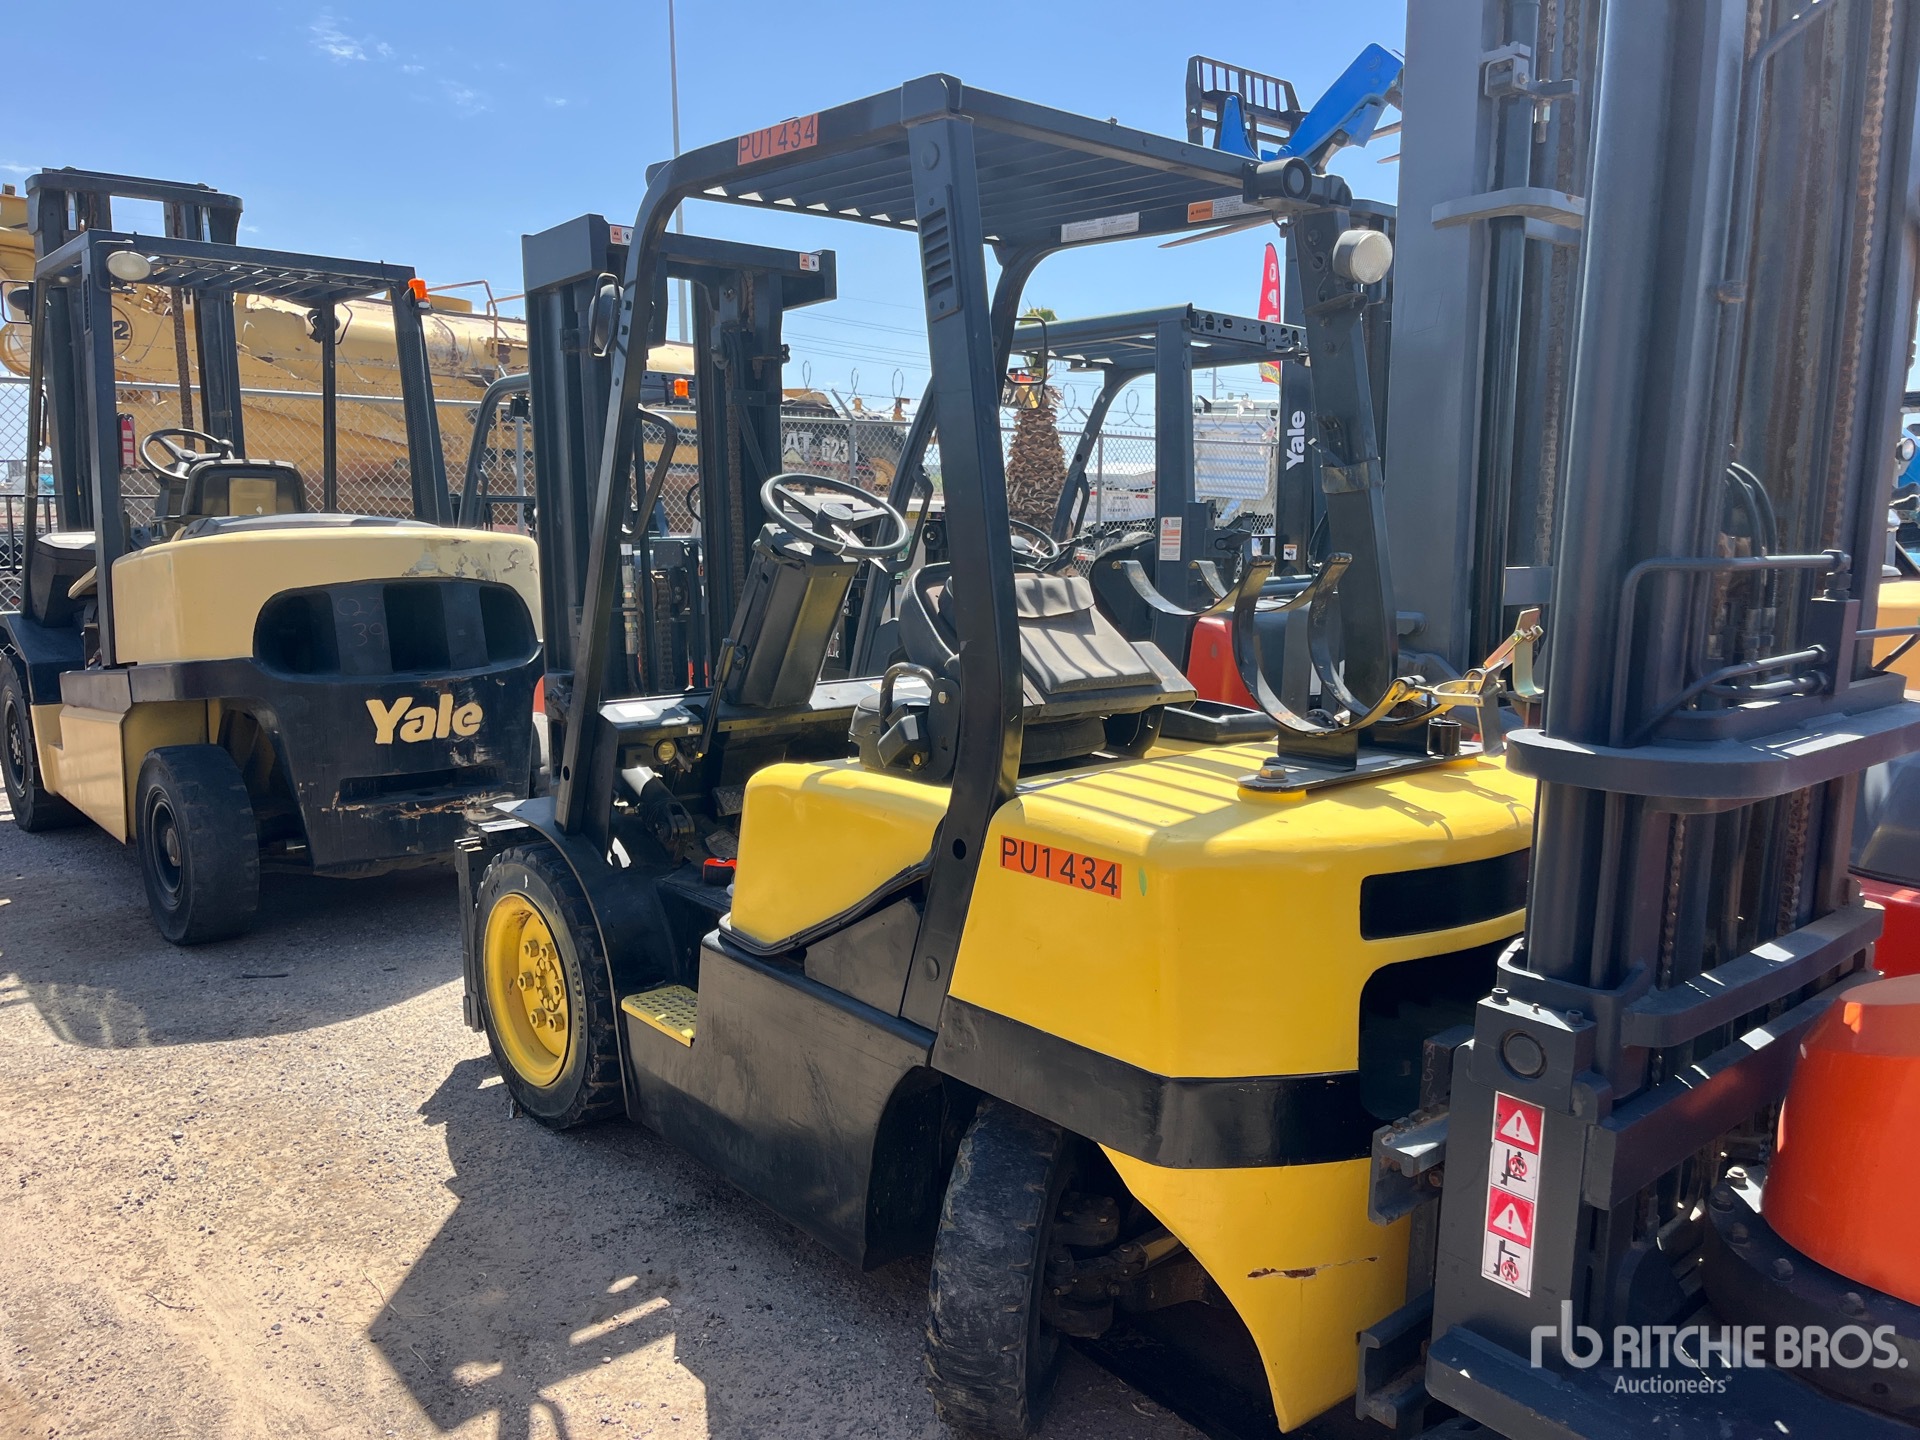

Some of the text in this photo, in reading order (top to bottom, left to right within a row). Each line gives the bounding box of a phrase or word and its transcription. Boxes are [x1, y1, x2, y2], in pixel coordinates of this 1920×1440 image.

[739, 115, 815, 162] PU1434
[783, 431, 858, 463] AT 623
[1286, 410, 1306, 471] Yale
[365, 693, 483, 744] Yale
[1002, 837, 1118, 896] PU1434
